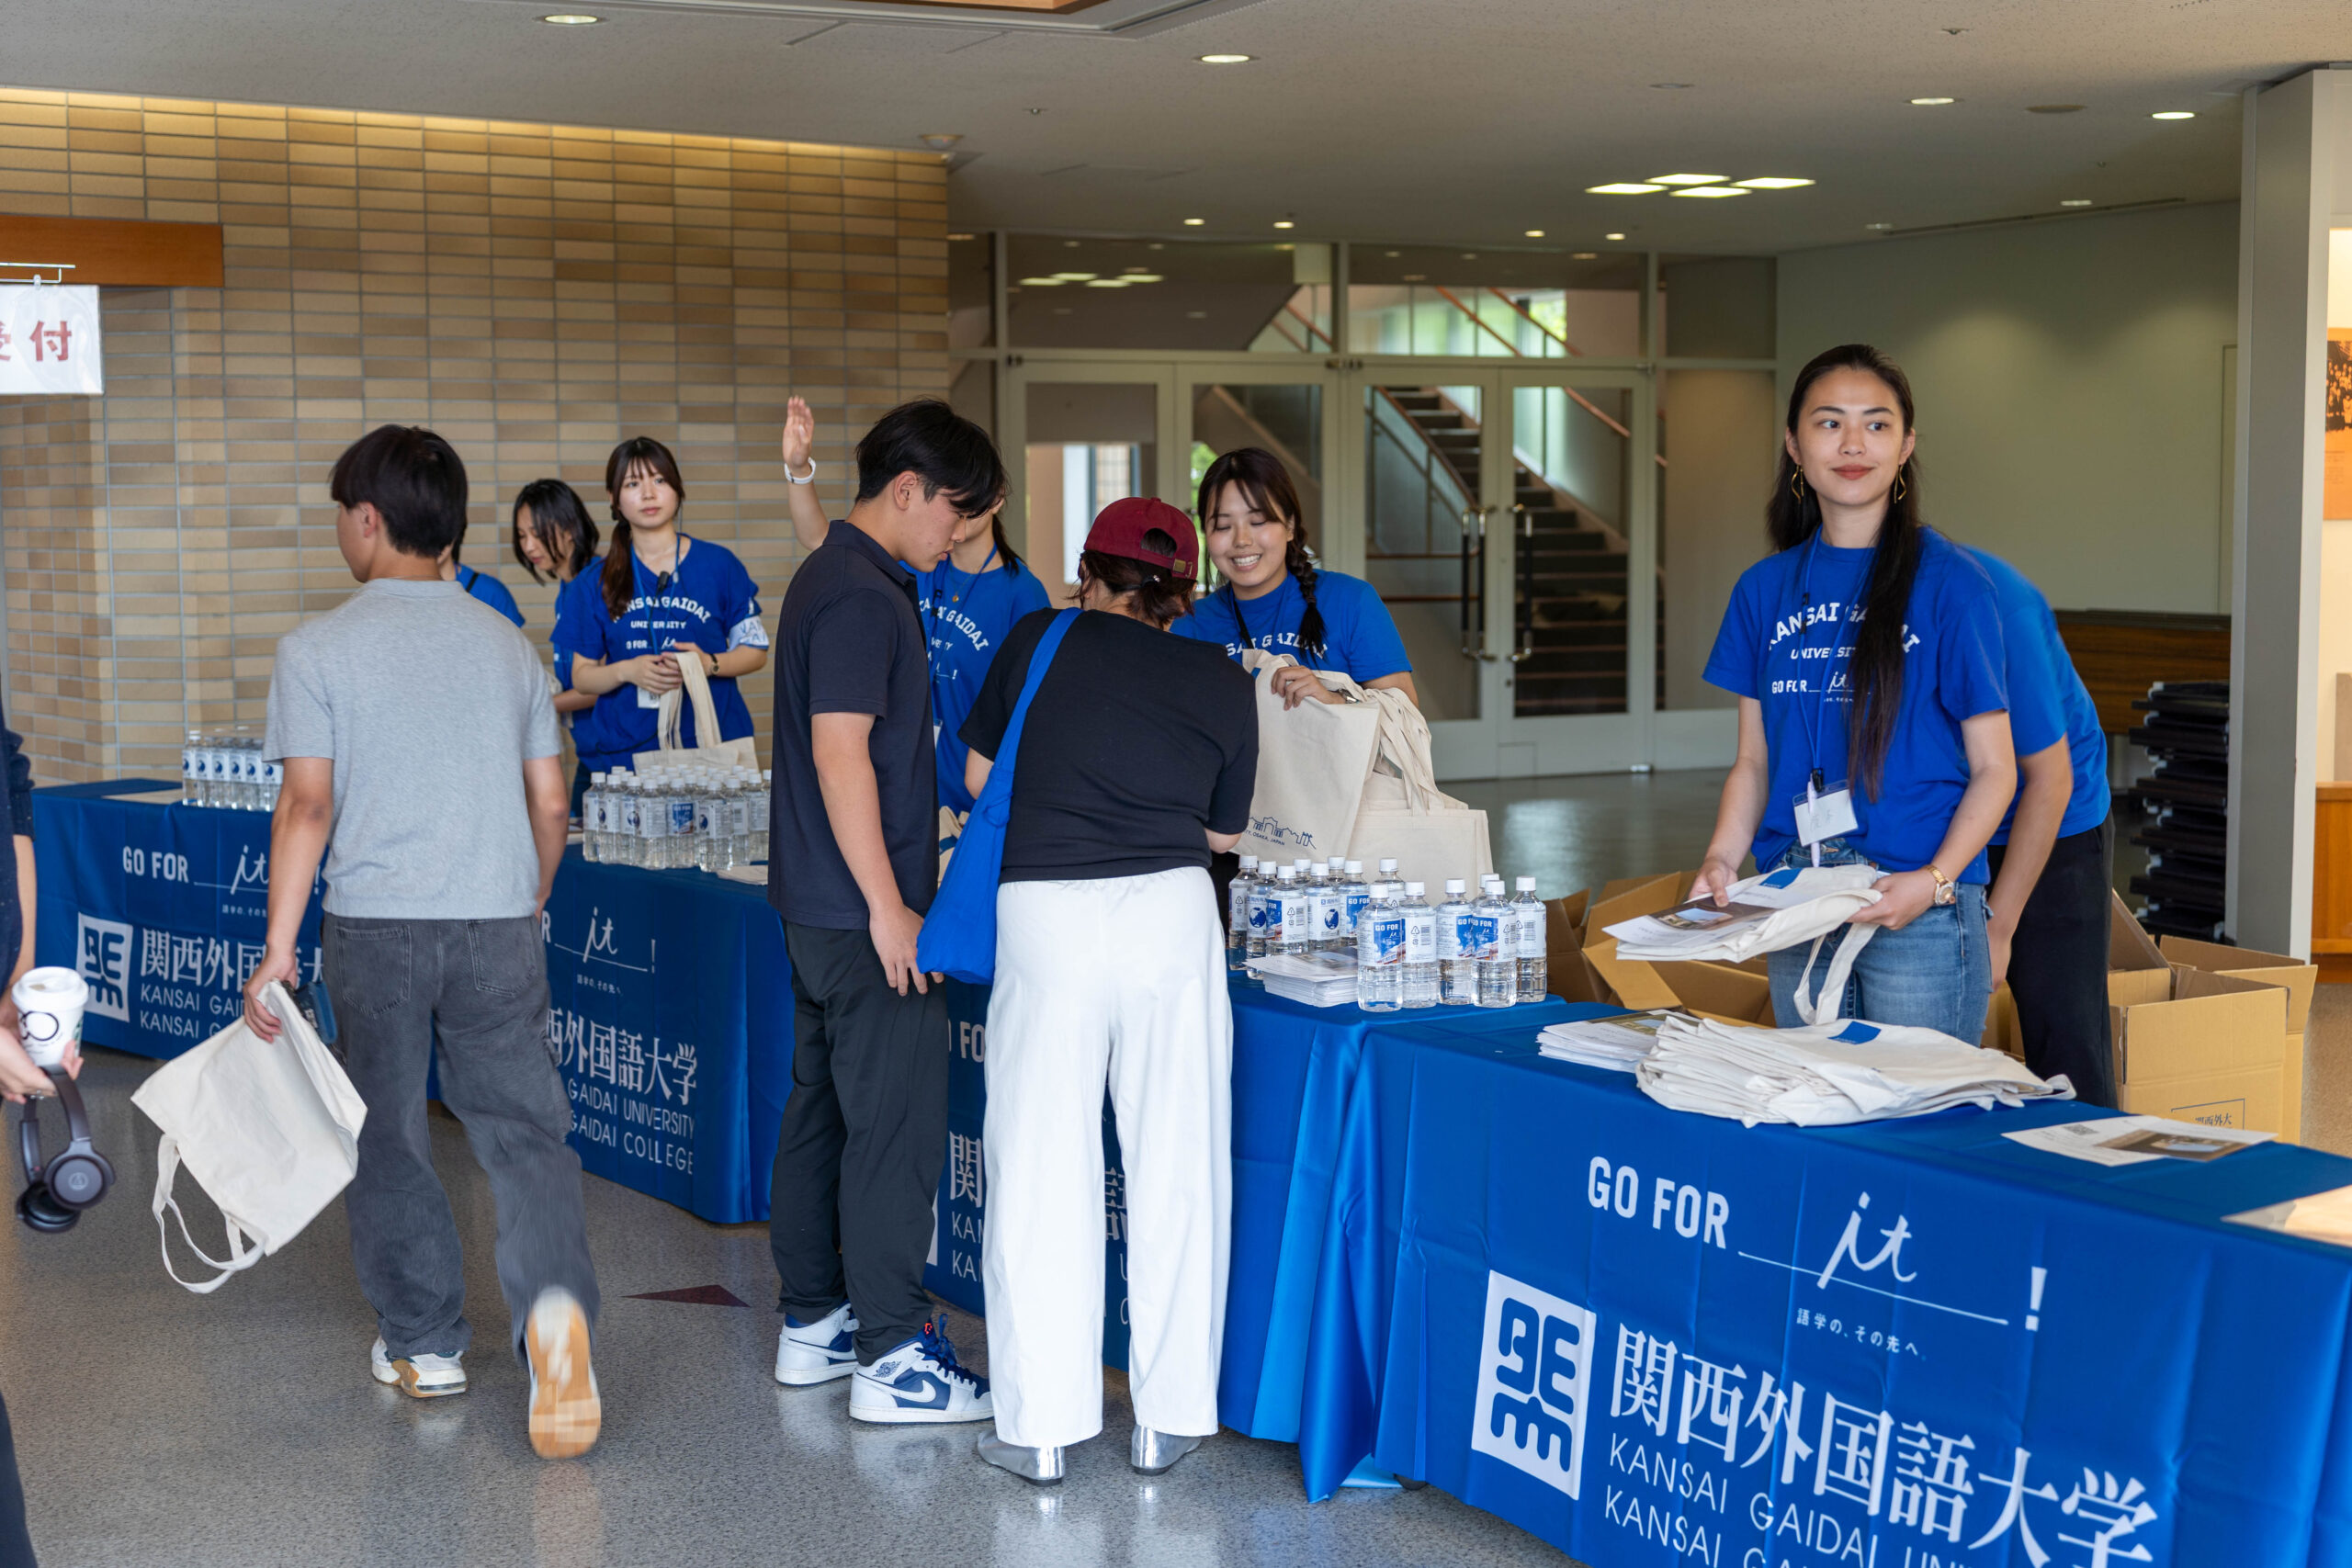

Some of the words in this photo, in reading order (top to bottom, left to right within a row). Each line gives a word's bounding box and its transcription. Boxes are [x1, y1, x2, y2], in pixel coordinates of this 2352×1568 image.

[945, 609, 989, 651] GAIDAI
[1771, 681, 1783, 694] GO
[122, 845, 144, 876] GO
[152, 852, 189, 883] FOR
[141, 983, 199, 1011] KANSAI
[139, 1010, 198, 1040] KANSAI
[568, 1078, 617, 1116] GAIDAI
[623, 1098, 695, 1140] UNIVERSITY
[624, 1132, 694, 1176] COLLEGE
[1588, 1156, 1639, 1220] GO
[1652, 1176, 1730, 1250] FOR
[1611, 1321, 2159, 1568] 関西外国語大学
[1610, 1432, 1727, 1515] KANSAI
[1749, 1492, 1879, 1568] GAIDAI
[1605, 1483, 1722, 1568] KANSAI
